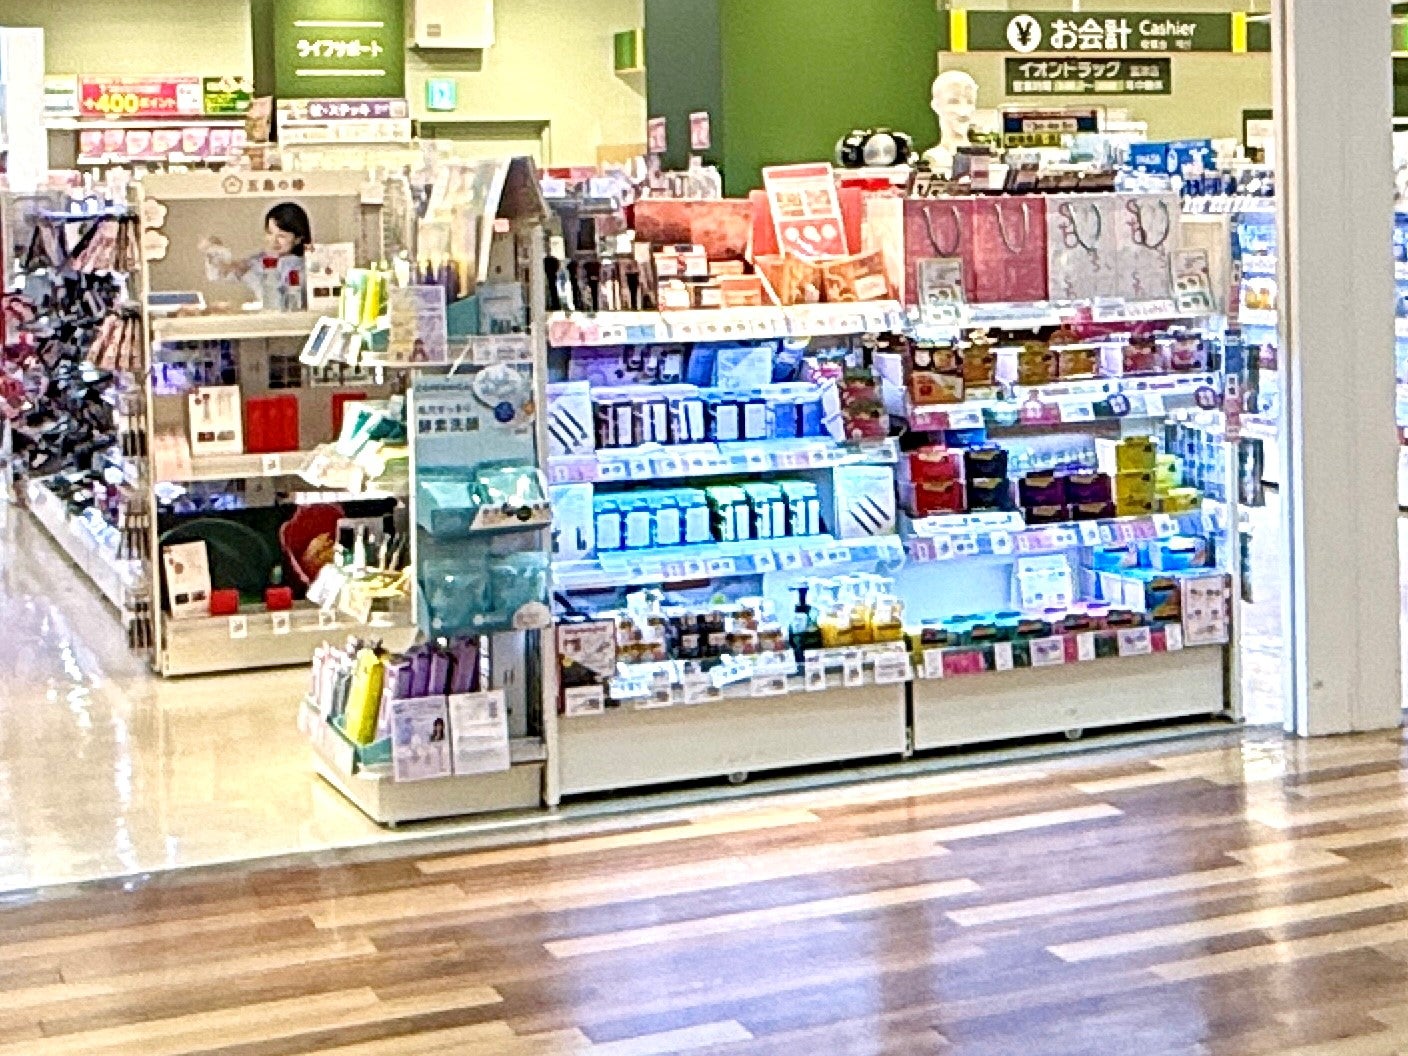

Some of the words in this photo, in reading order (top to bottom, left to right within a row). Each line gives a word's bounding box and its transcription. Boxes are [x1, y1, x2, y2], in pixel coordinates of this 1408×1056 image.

[1050, 17, 1132, 50] お会計
[1139, 19, 1197, 38] Cashier
[296, 39, 384, 58] ライフサポート
[1018, 60, 1121, 79] イオンドラッグ
